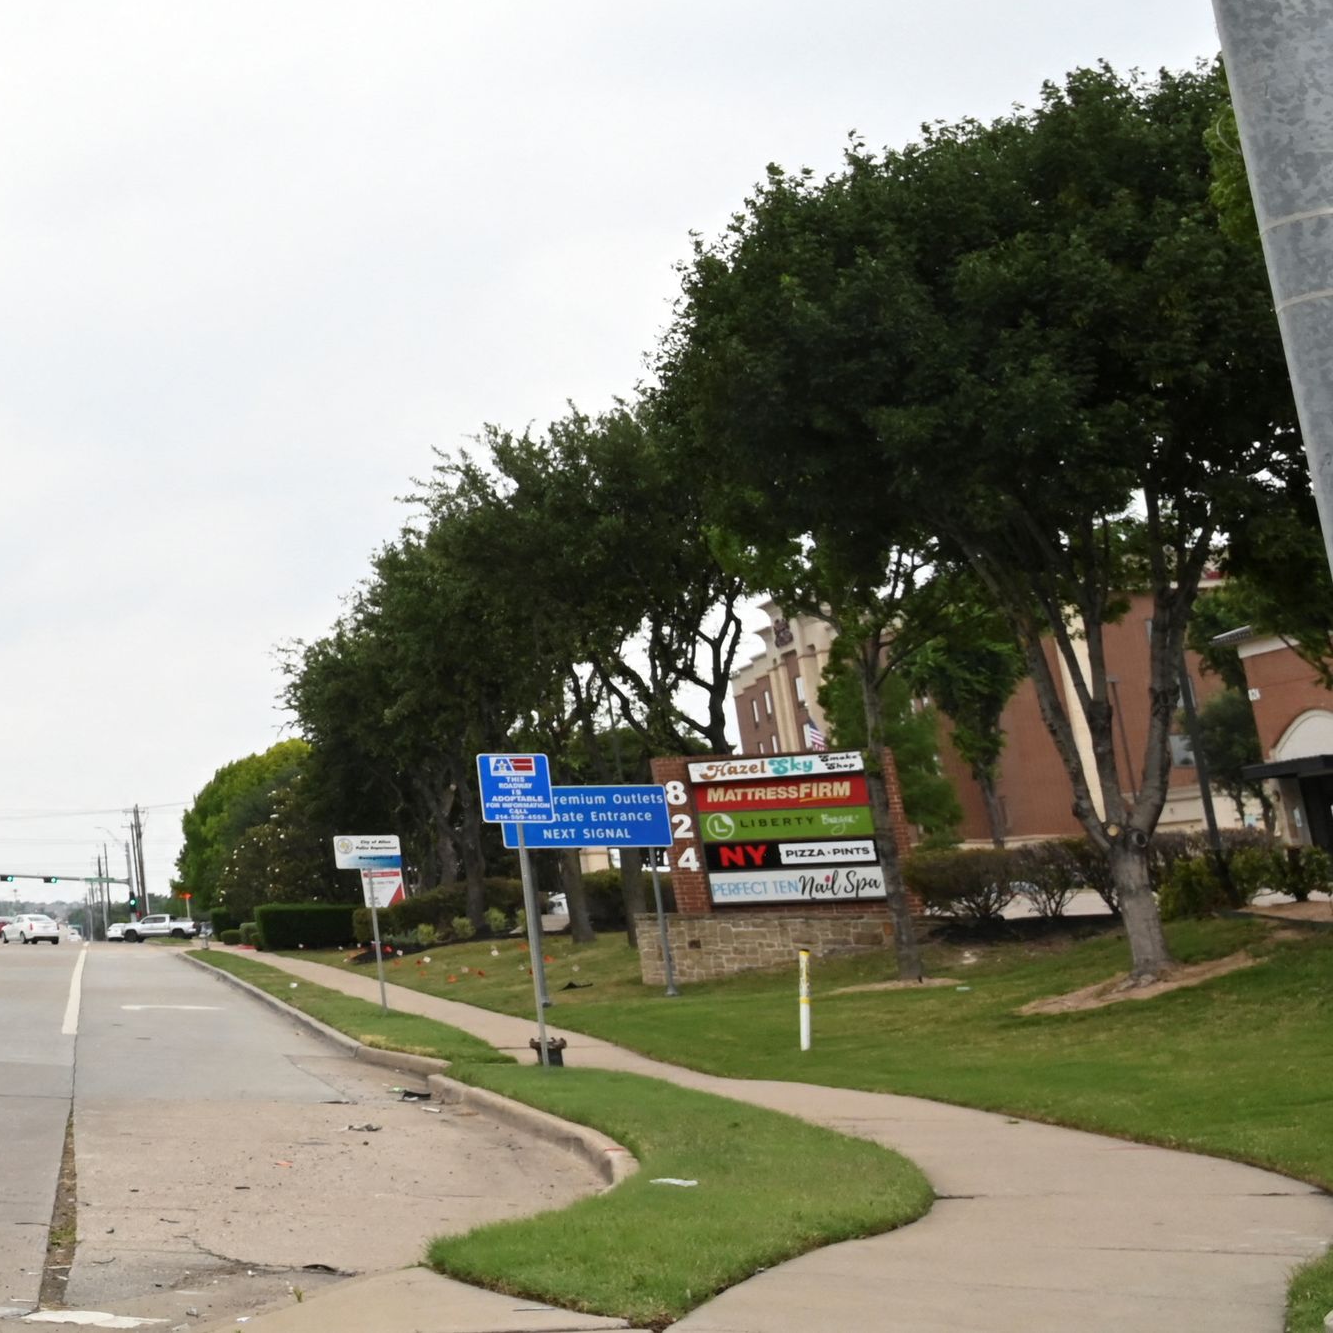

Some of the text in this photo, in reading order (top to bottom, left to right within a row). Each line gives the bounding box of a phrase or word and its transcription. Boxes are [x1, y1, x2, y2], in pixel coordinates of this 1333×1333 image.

[818, 753, 857, 763] Smoke
[699, 757, 813, 780] Hazel Sky
[824, 762, 856, 771] Shop
[553, 793, 664, 805] remium Outlets
[590, 811, 652, 822] Entrance
[739, 817, 814, 828] LIBERTY
[543, 828, 632, 839] NEXT SIGNAL
[719, 844, 871, 867] NY PIZZA PINTS
[713, 870, 882, 898] PERFECT TEN Nail Spa
